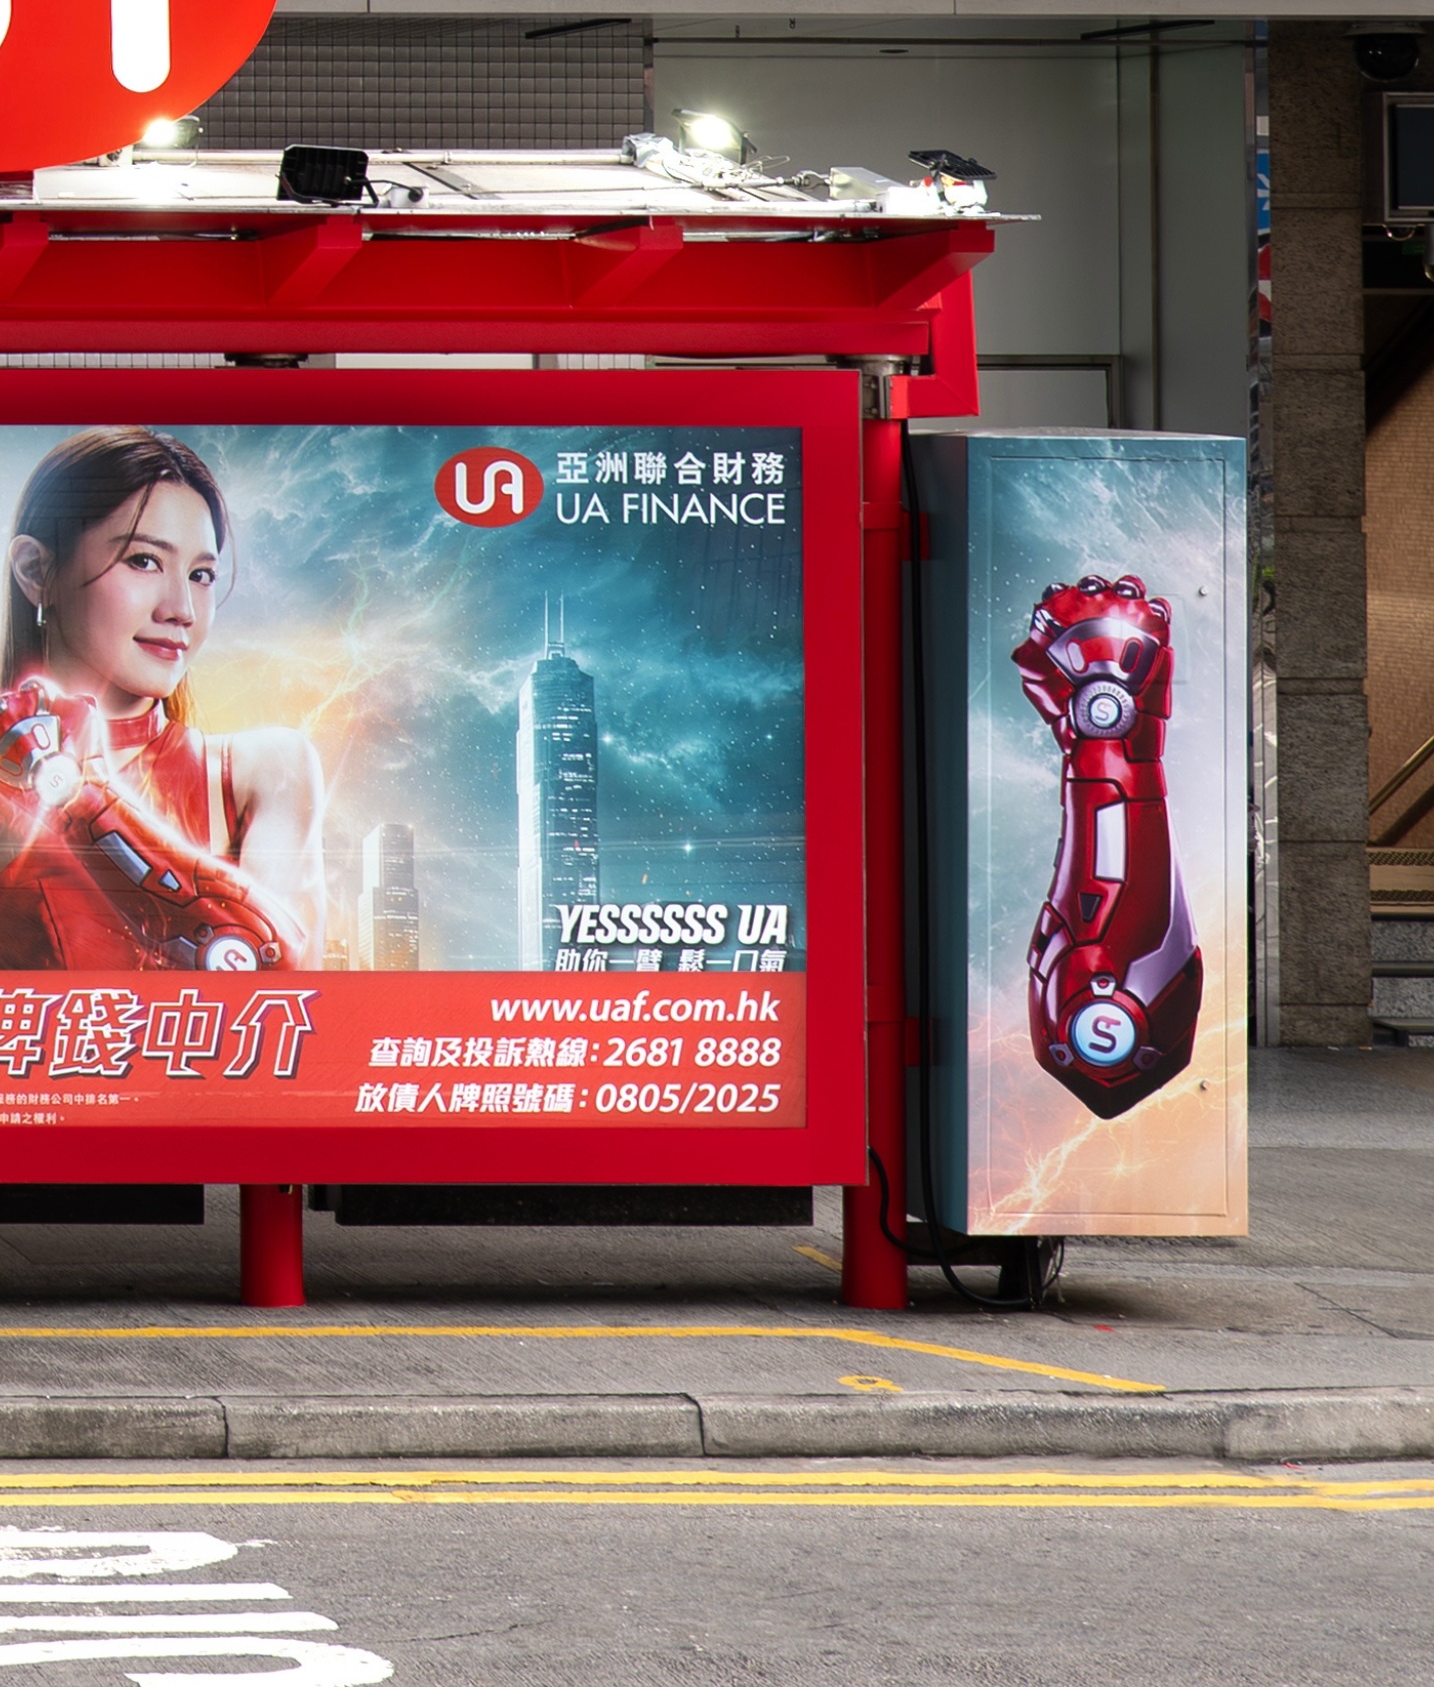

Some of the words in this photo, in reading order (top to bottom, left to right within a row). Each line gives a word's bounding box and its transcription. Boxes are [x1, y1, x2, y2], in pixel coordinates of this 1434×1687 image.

[556, 451, 785, 485] 亞洲聯合財務
[556, 492, 610, 524] UA
[623, 492, 785, 524] FINANCE
[554, 904, 728, 944] YESSSSSS
[737, 904, 788, 944] UA
[490, 991, 780, 1023] www.uaf.com.hk
